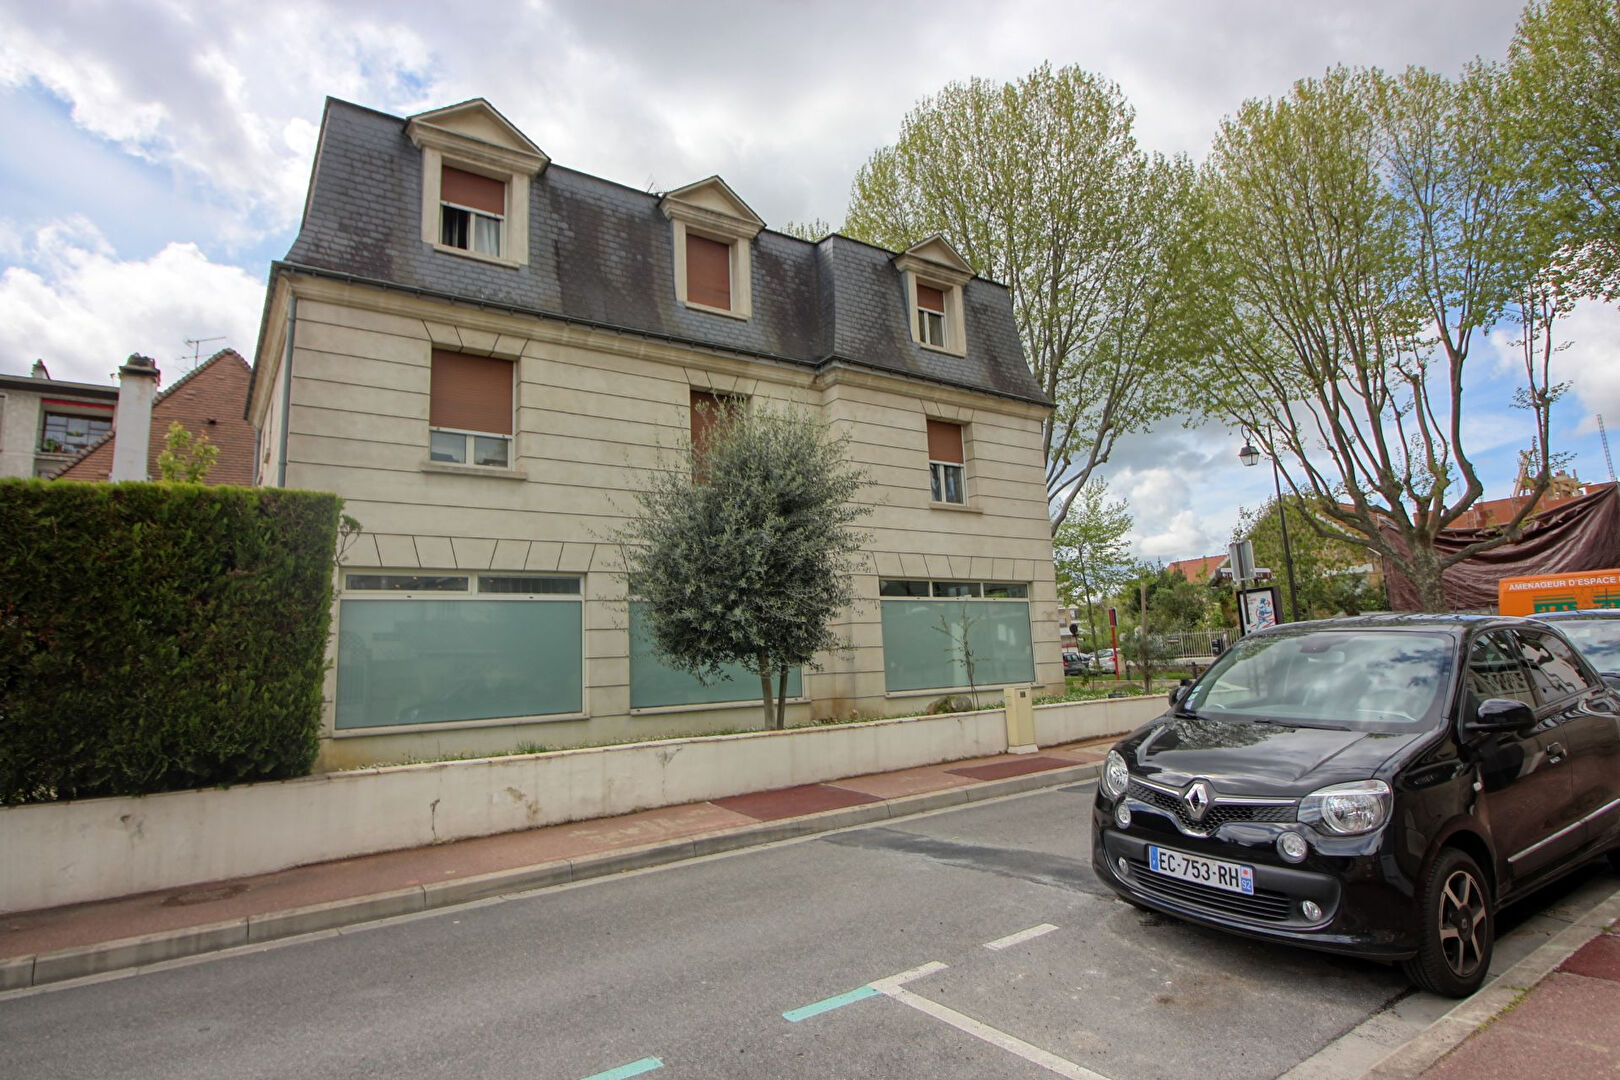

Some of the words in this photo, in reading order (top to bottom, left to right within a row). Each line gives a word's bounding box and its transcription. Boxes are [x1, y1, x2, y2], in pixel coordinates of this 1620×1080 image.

[1508, 580, 1566, 591] AMENAGEUR
[1568, 576, 1616, 587] D'ESPACE
[1160, 852, 1239, 888] EC-753-RH
[1241, 880, 1251, 890] 92
